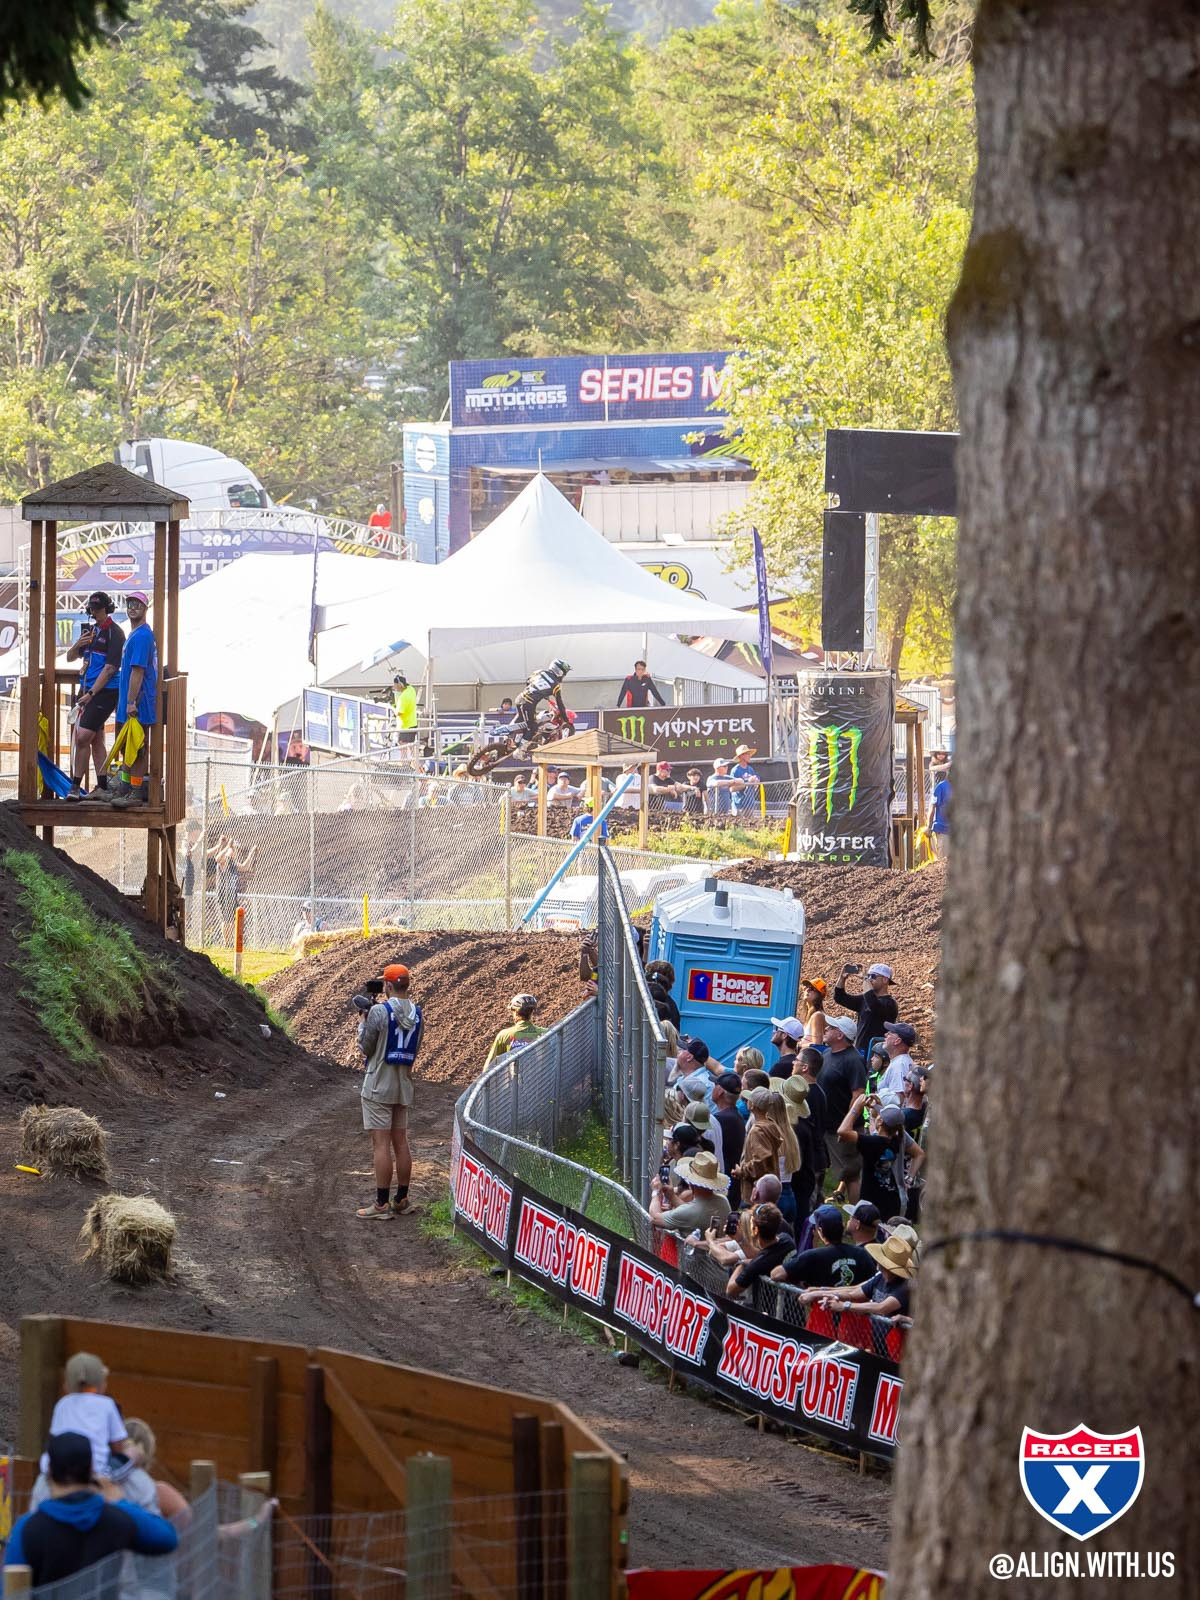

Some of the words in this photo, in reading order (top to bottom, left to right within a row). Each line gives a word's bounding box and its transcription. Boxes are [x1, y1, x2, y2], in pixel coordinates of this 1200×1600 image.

[580, 367, 693, 402] SERIES
[465, 391, 567, 408] MOTOCROSS
[465, 404, 568, 413] CHAMPIONSHIP
[202, 534, 242, 547] 2024
[652, 717, 756, 738] MONSTER
[668, 738, 740, 748] ENERGY
[712, 973, 765, 994] Honey
[711, 987, 769, 1005] Bucket
[394, 1026, 416, 1049] 17
